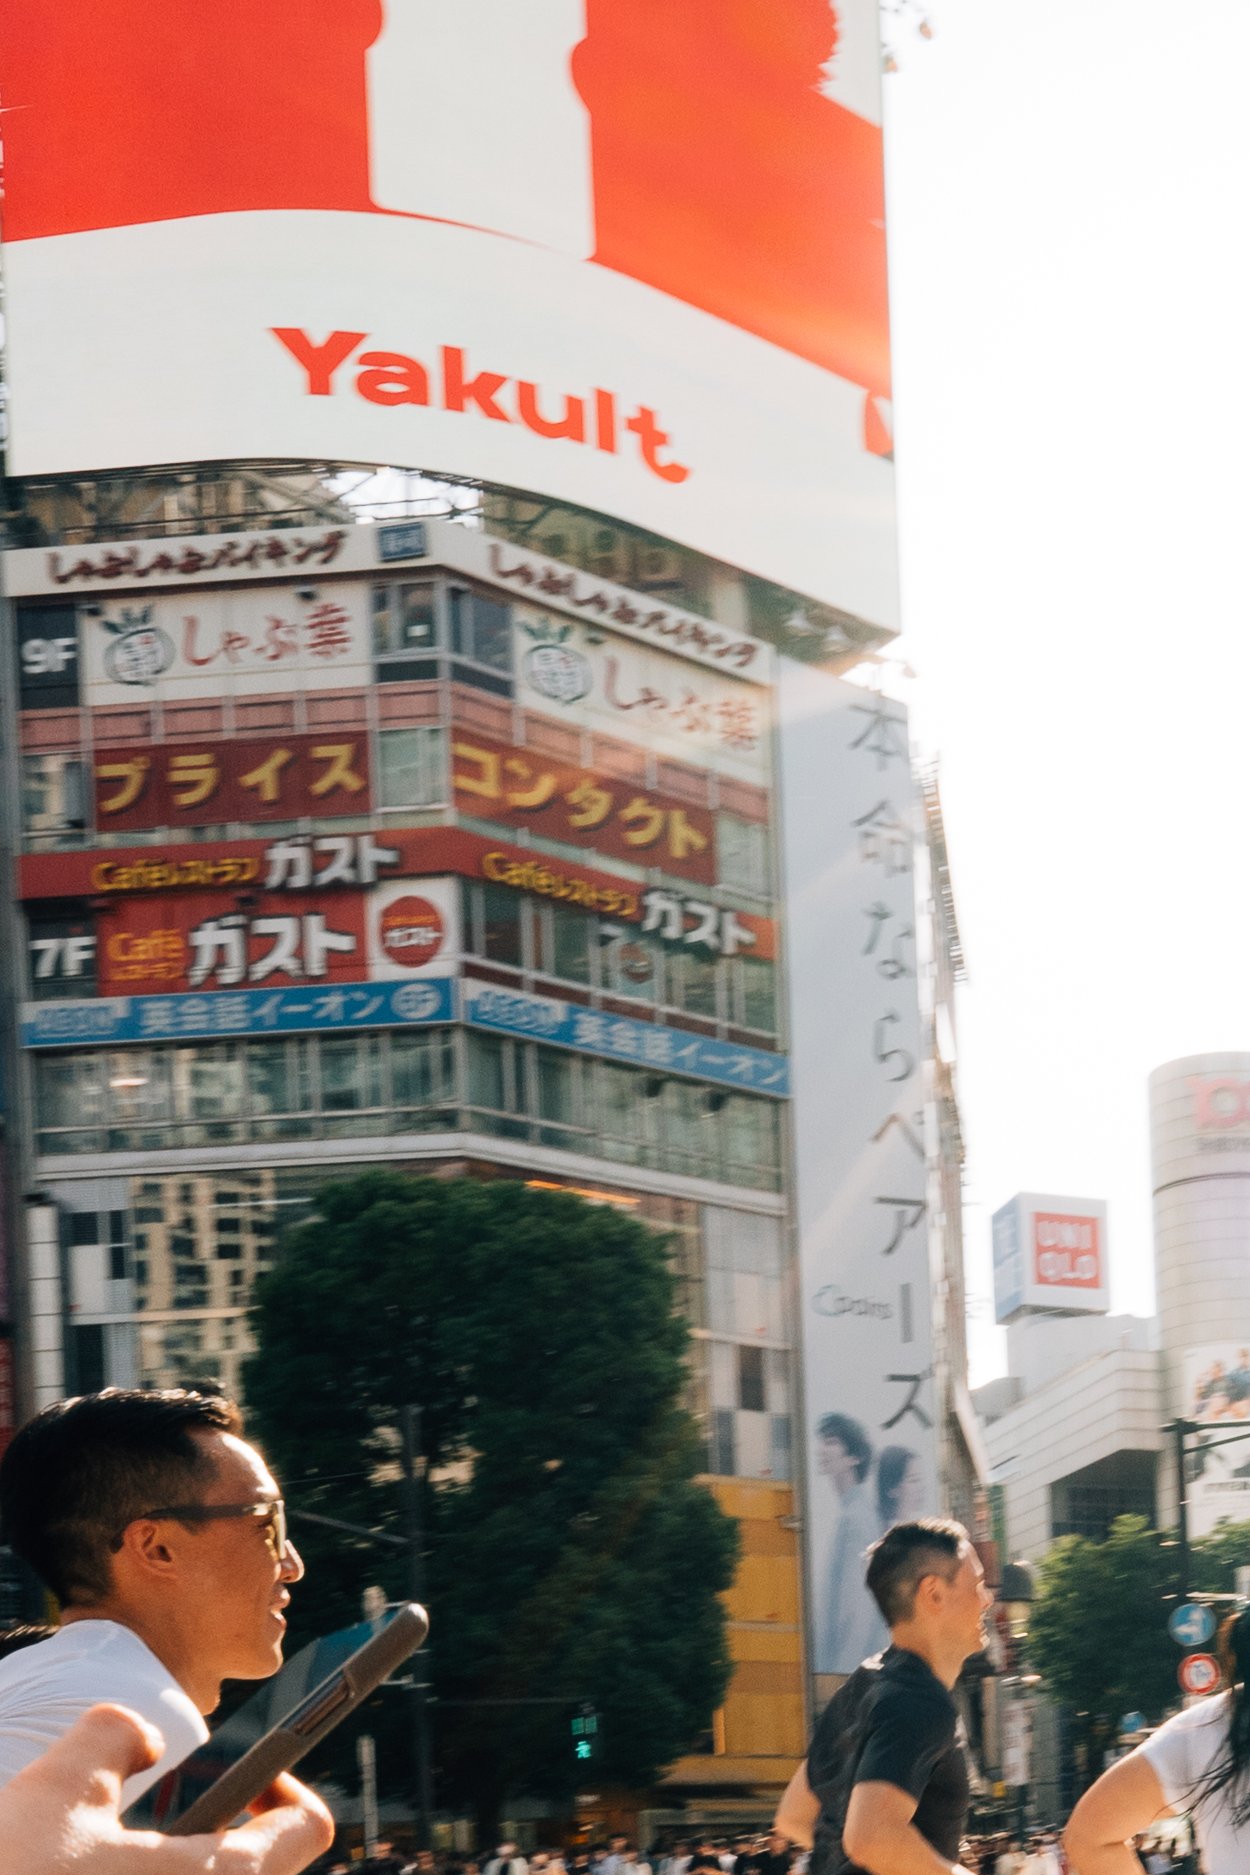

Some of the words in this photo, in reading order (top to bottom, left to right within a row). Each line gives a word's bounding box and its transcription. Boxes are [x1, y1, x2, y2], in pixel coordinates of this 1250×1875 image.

[271, 327, 691, 484] Yakult
[21, 637, 77, 674] 9F
[181, 601, 353, 667] しゃぶ葉
[96, 743, 368, 813] プライス
[453, 741, 710, 860] コンタクト
[264, 833, 399, 890] ガスト
[187, 911, 358, 988] ガスト
[641, 888, 759, 957] ガスト
[29, 937, 96, 979] 7F
